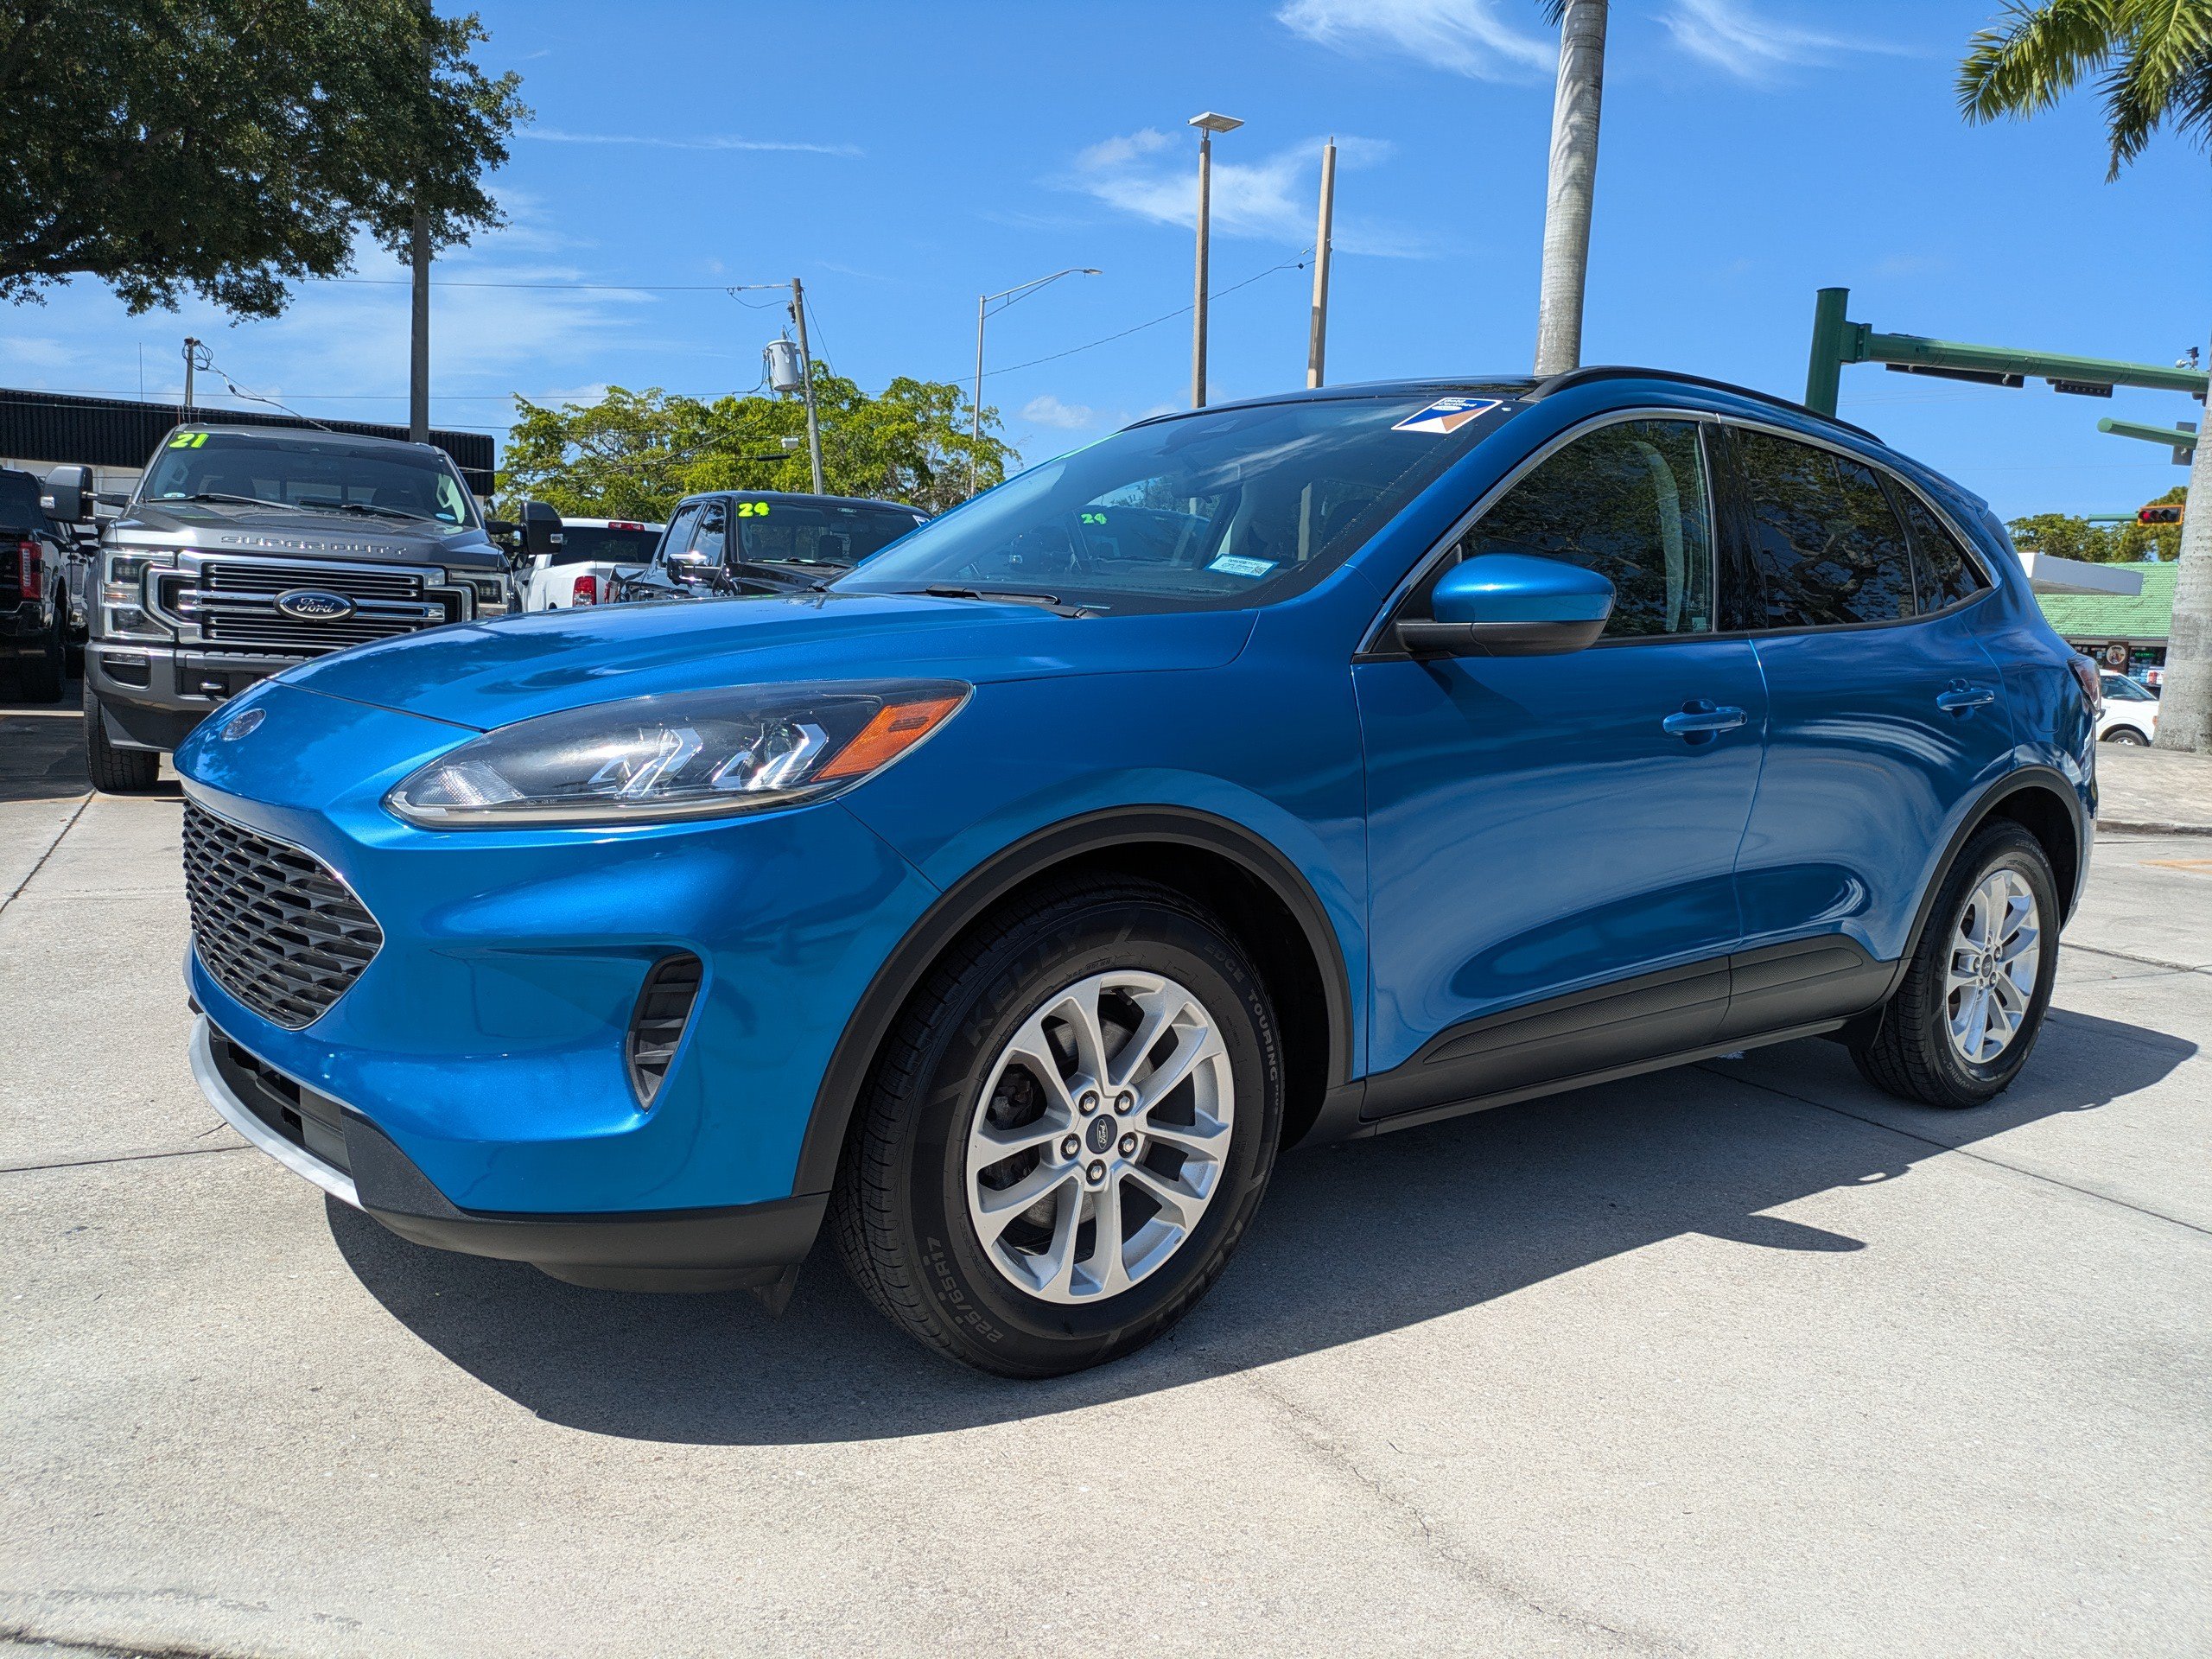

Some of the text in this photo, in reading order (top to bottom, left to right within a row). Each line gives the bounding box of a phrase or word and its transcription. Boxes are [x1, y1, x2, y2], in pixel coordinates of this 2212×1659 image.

[169, 433, 209, 448] 21
[738, 502, 770, 517] 24
[221, 536, 407, 556] SUPER DUTY
[296, 597, 334, 614] Ford
[1204, 943, 1246, 983] EDGE
[1248, 989, 1279, 1081] TOURING
[927, 1236, 1004, 1343] 225/65R17
